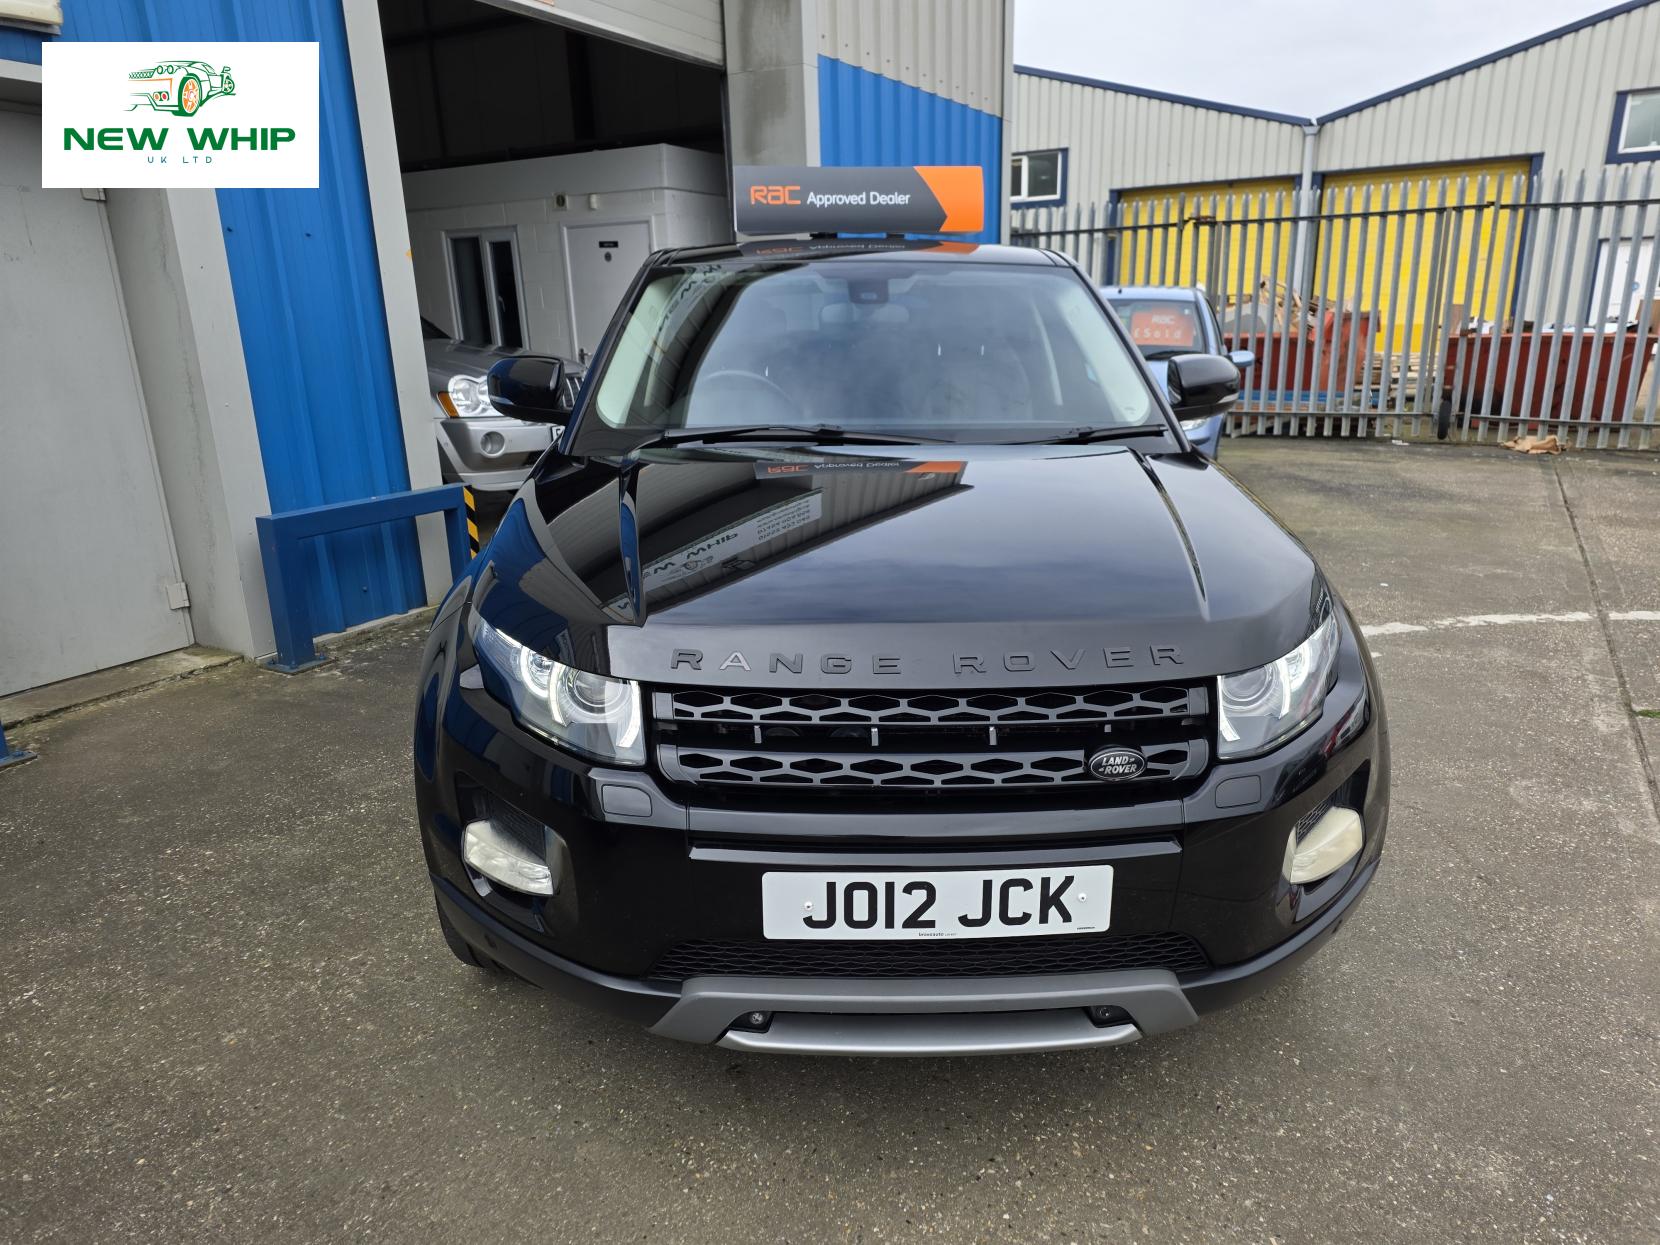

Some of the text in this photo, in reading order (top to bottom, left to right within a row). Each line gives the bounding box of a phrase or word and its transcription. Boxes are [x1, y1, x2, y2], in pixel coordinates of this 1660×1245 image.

[806, 191, 866, 208] Approved
[870, 191, 911, 205] Dealer
[670, 644, 1184, 675] RANGE ROVER
[1102, 755, 1130, 766] LAND
[1104, 763, 1138, 775] ROVER
[802, 875, 1075, 929] JO12 JCK
